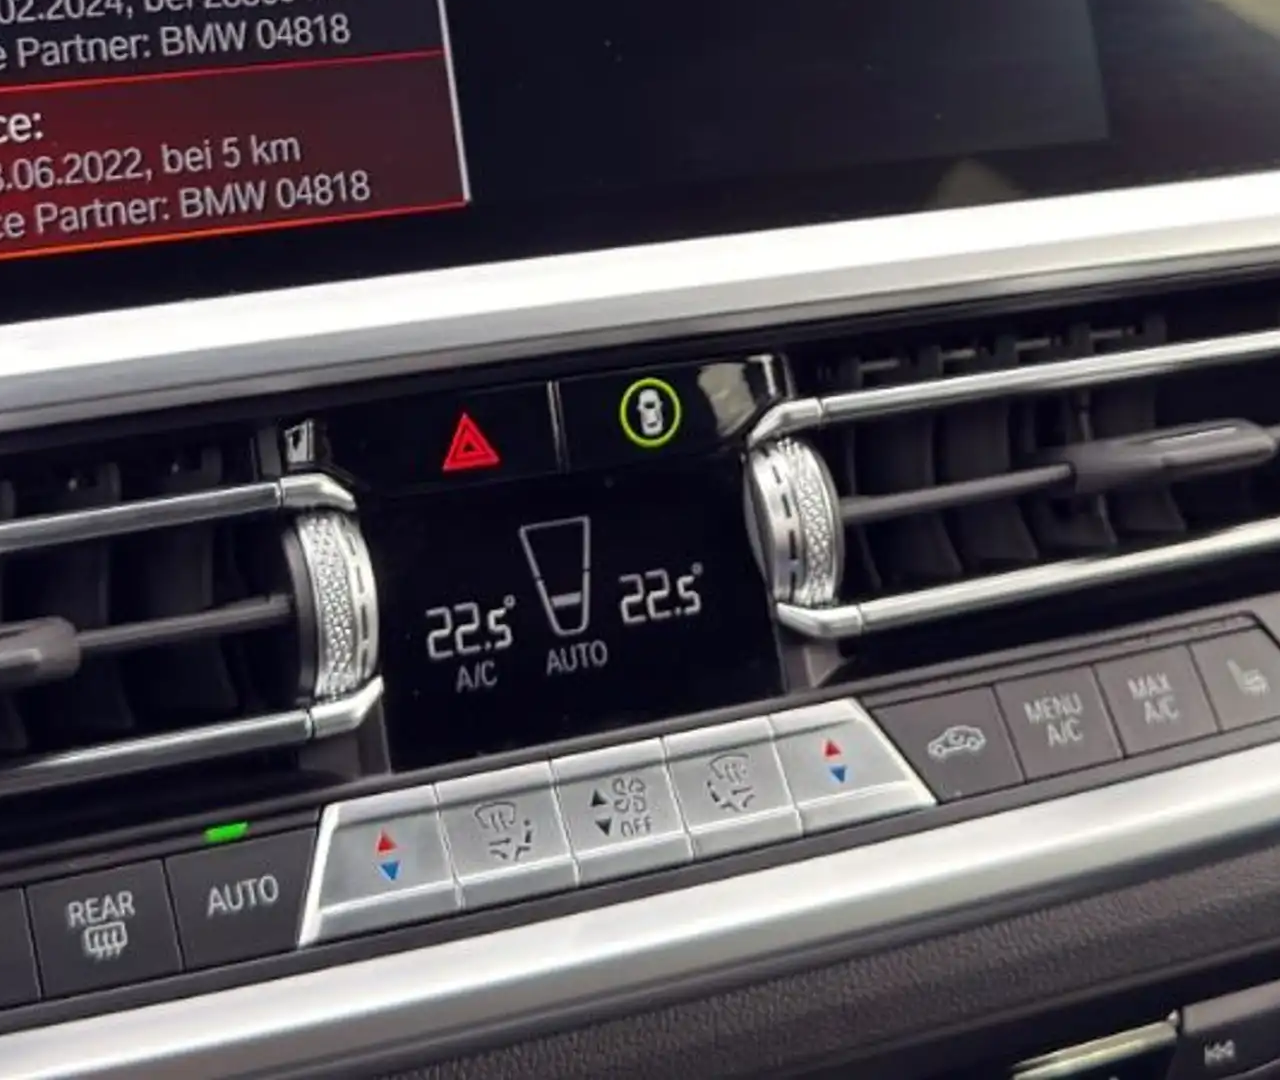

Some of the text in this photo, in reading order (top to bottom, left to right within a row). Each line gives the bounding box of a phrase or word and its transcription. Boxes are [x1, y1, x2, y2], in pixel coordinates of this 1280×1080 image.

[17, 29, 151, 71] Partner:
[160, 22, 246, 57] BMW
[255, 14, 350, 49] 04818
[161, 141, 213, 177] bei
[222, 139, 241, 169] 5
[251, 134, 301, 167] km
[35, 195, 169, 238] Partner:
[178, 184, 266, 220] BMW
[274, 172, 370, 210] 04818
[546, 640, 608, 675] AUTO
[456, 662, 498, 692] A/C
[1128, 675, 1171, 703] MAX
[1024, 693, 1083, 725] MENU
[1145, 696, 1180, 723] A/C
[1048, 720, 1083, 747] A/C
[68, 892, 134, 927] REAR
[208, 876, 279, 916] AUTO
